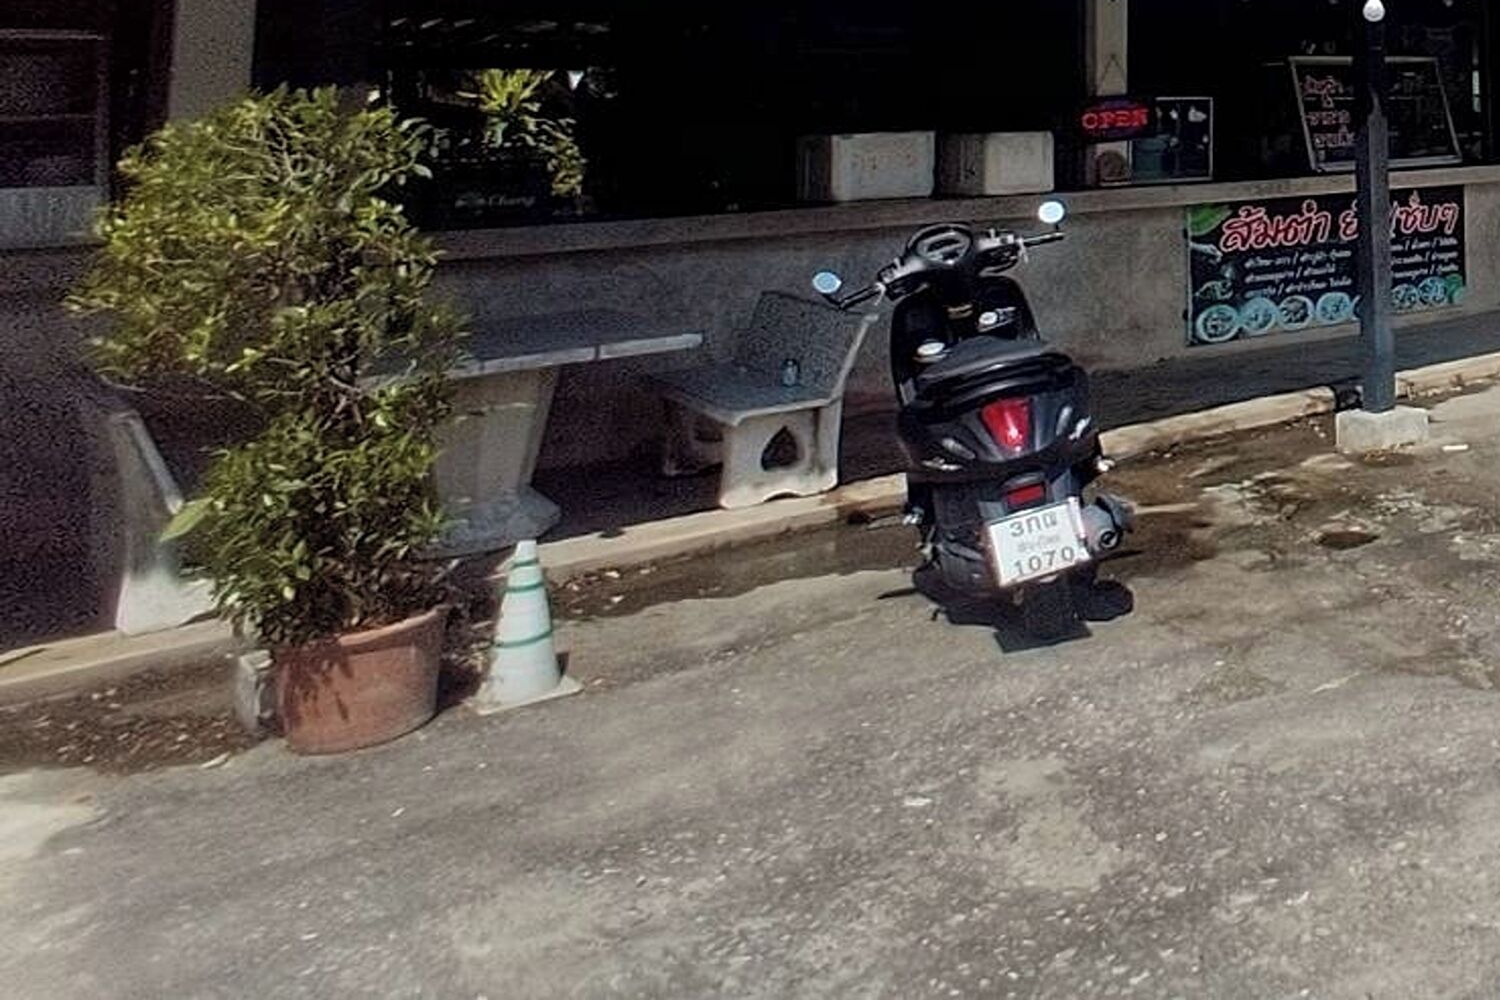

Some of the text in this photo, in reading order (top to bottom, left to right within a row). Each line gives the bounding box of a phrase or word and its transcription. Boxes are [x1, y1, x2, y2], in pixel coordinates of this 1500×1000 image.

[1081, 108, 1149, 129] OPEN
[1220, 199, 1332, 252] ส้มตำ
[1014, 546, 1075, 577] 1070
